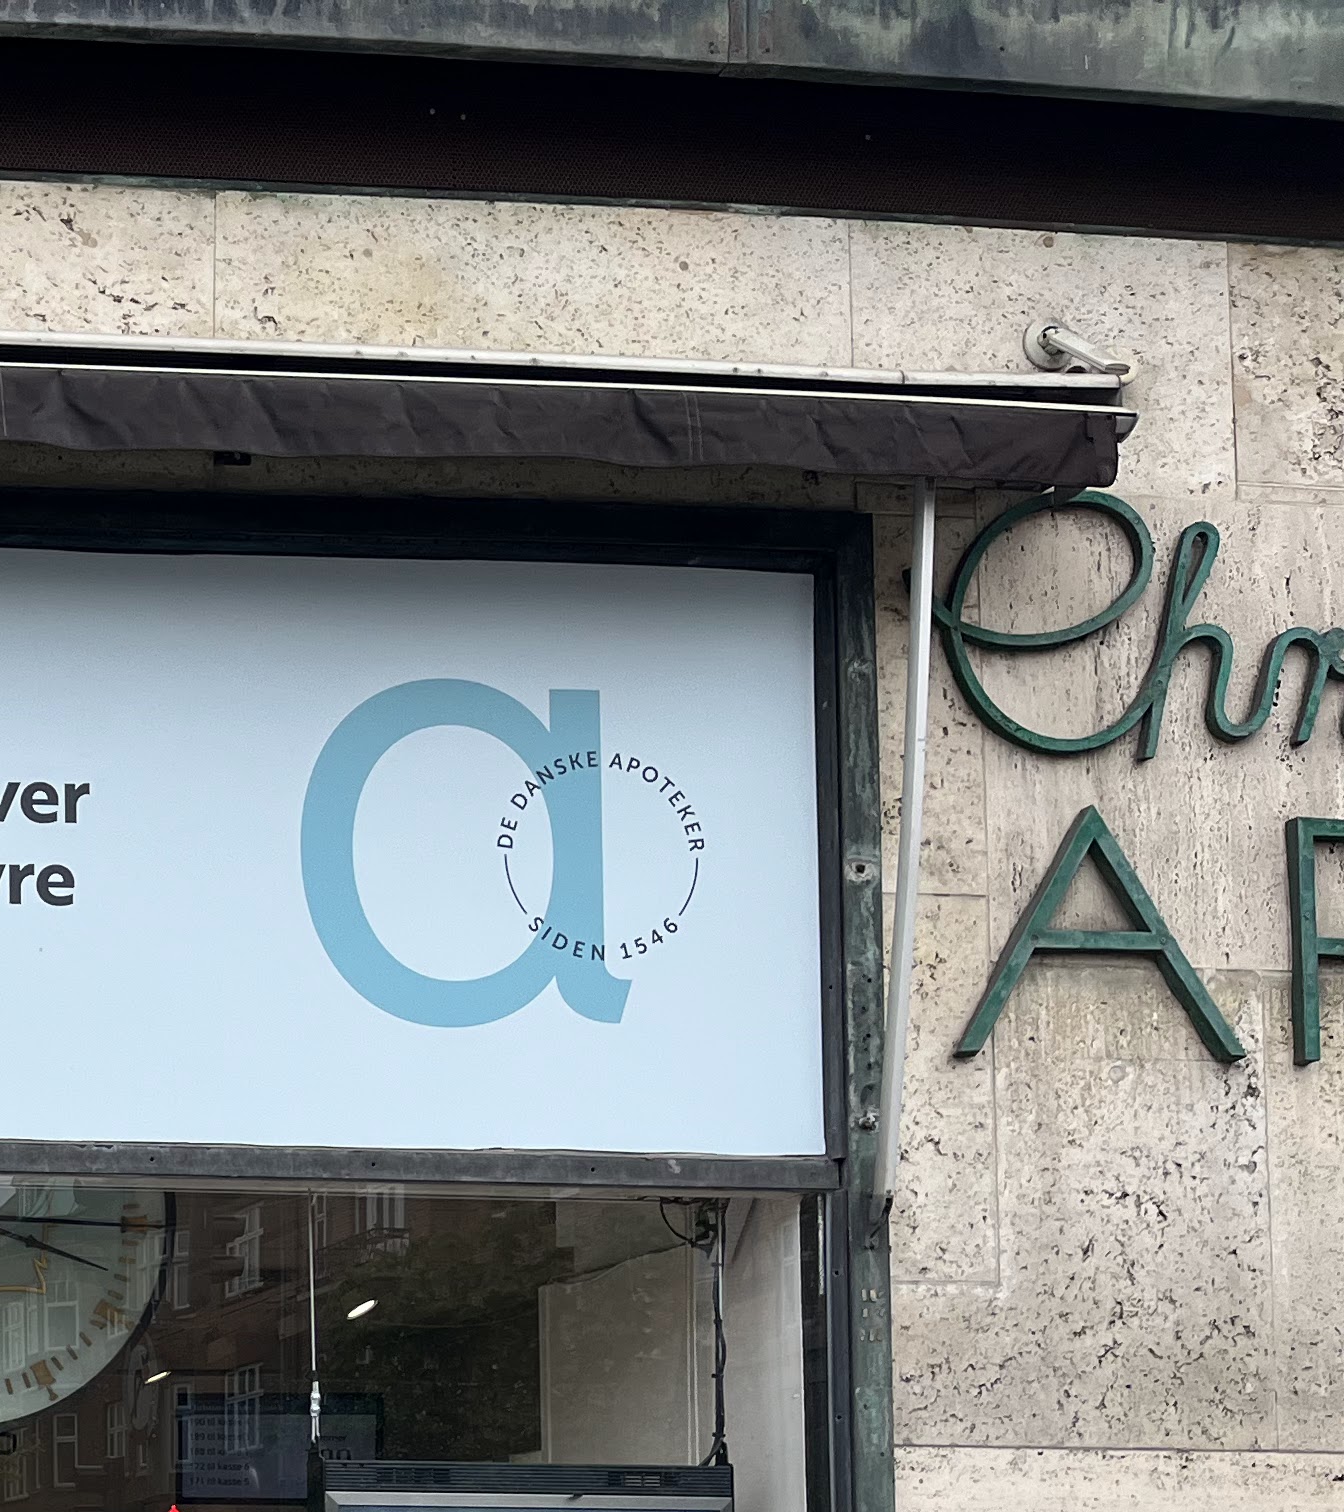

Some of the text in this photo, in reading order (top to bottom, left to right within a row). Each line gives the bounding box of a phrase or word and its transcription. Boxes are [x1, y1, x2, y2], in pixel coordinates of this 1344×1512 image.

[497, 750, 705, 852] DE DANSKE APOTEKER
[527, 915, 680, 961] SIDEN 1546
